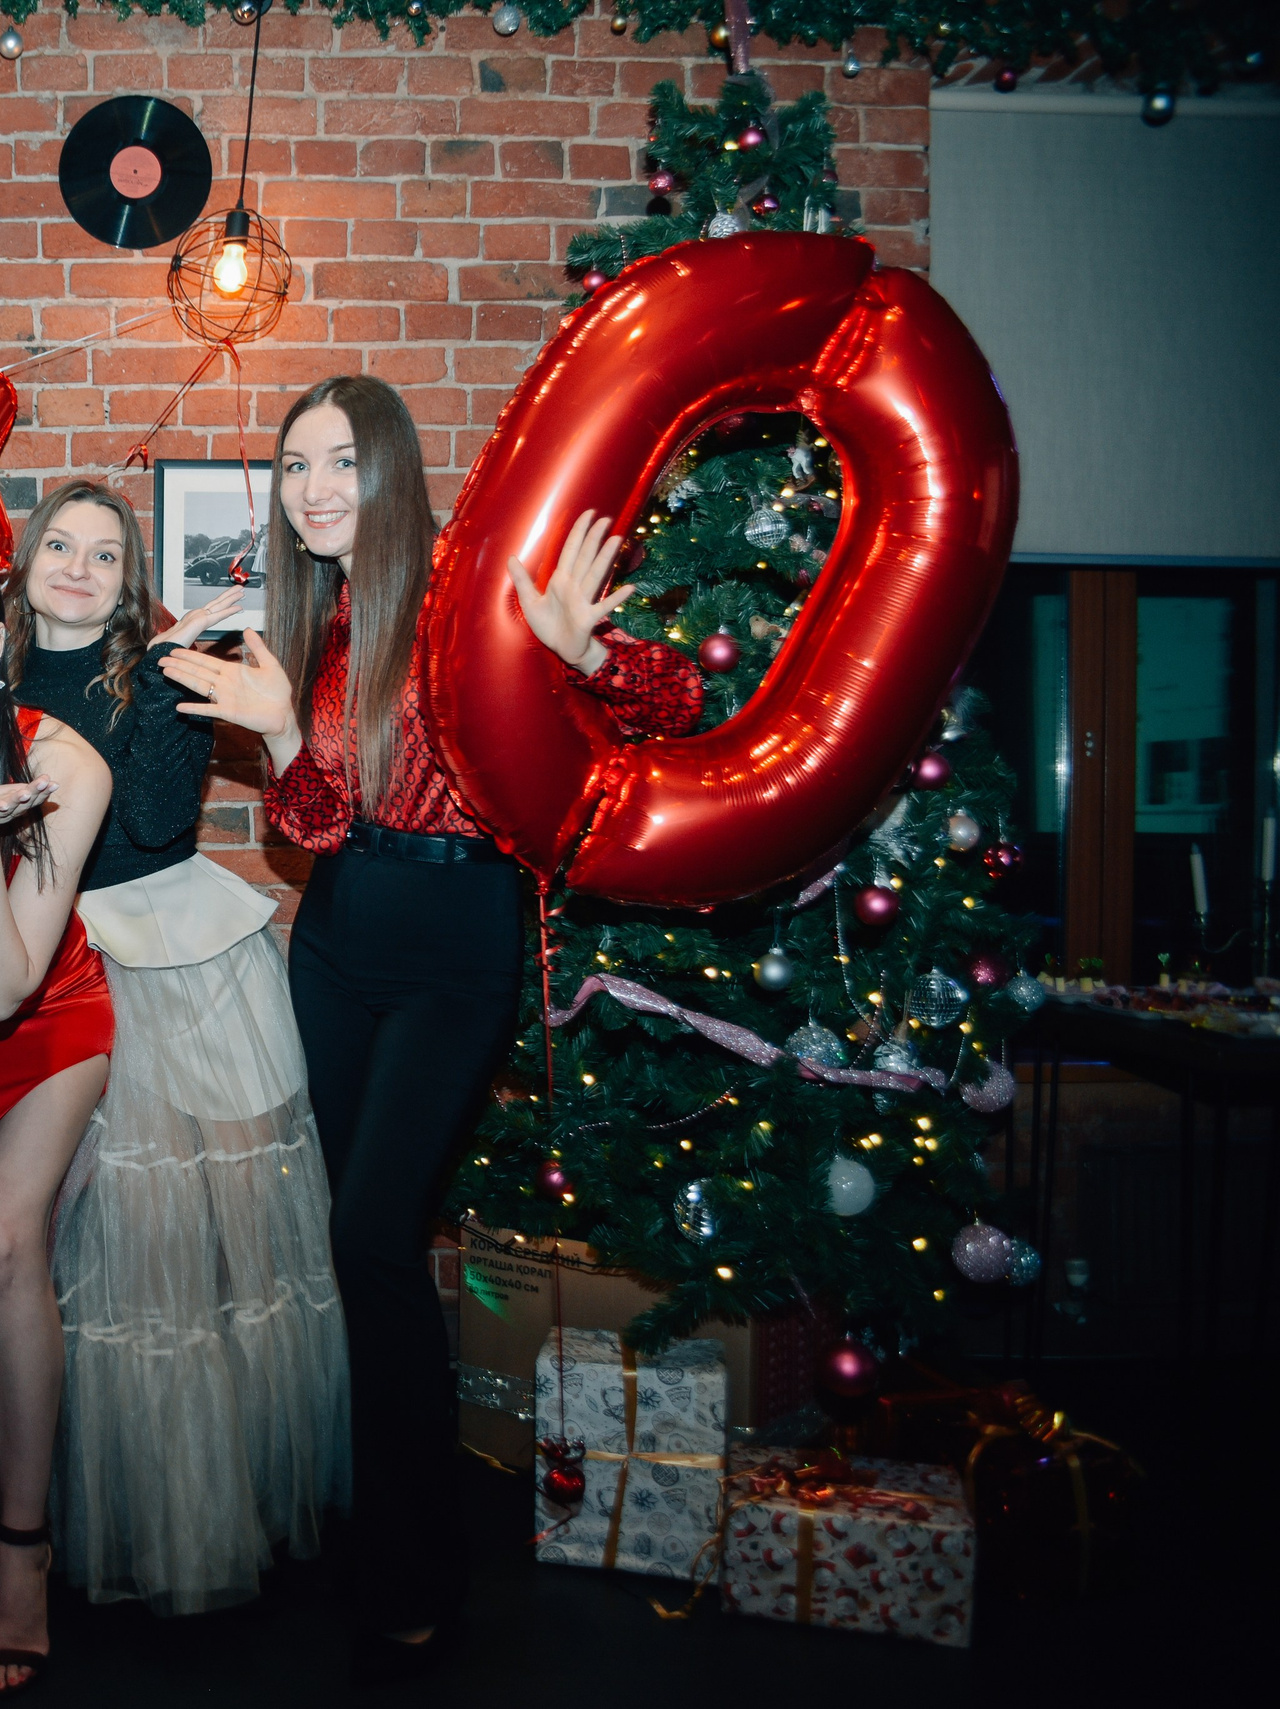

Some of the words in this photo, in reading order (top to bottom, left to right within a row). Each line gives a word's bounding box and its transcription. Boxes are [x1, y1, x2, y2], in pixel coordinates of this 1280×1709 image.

[420, 231, 1019, 911] 0
[469, 1255, 513, 1272] ОРТАША
[470, 1237, 511, 1254] КОР
[515, 1246, 580, 1268] СРЕИЙ
